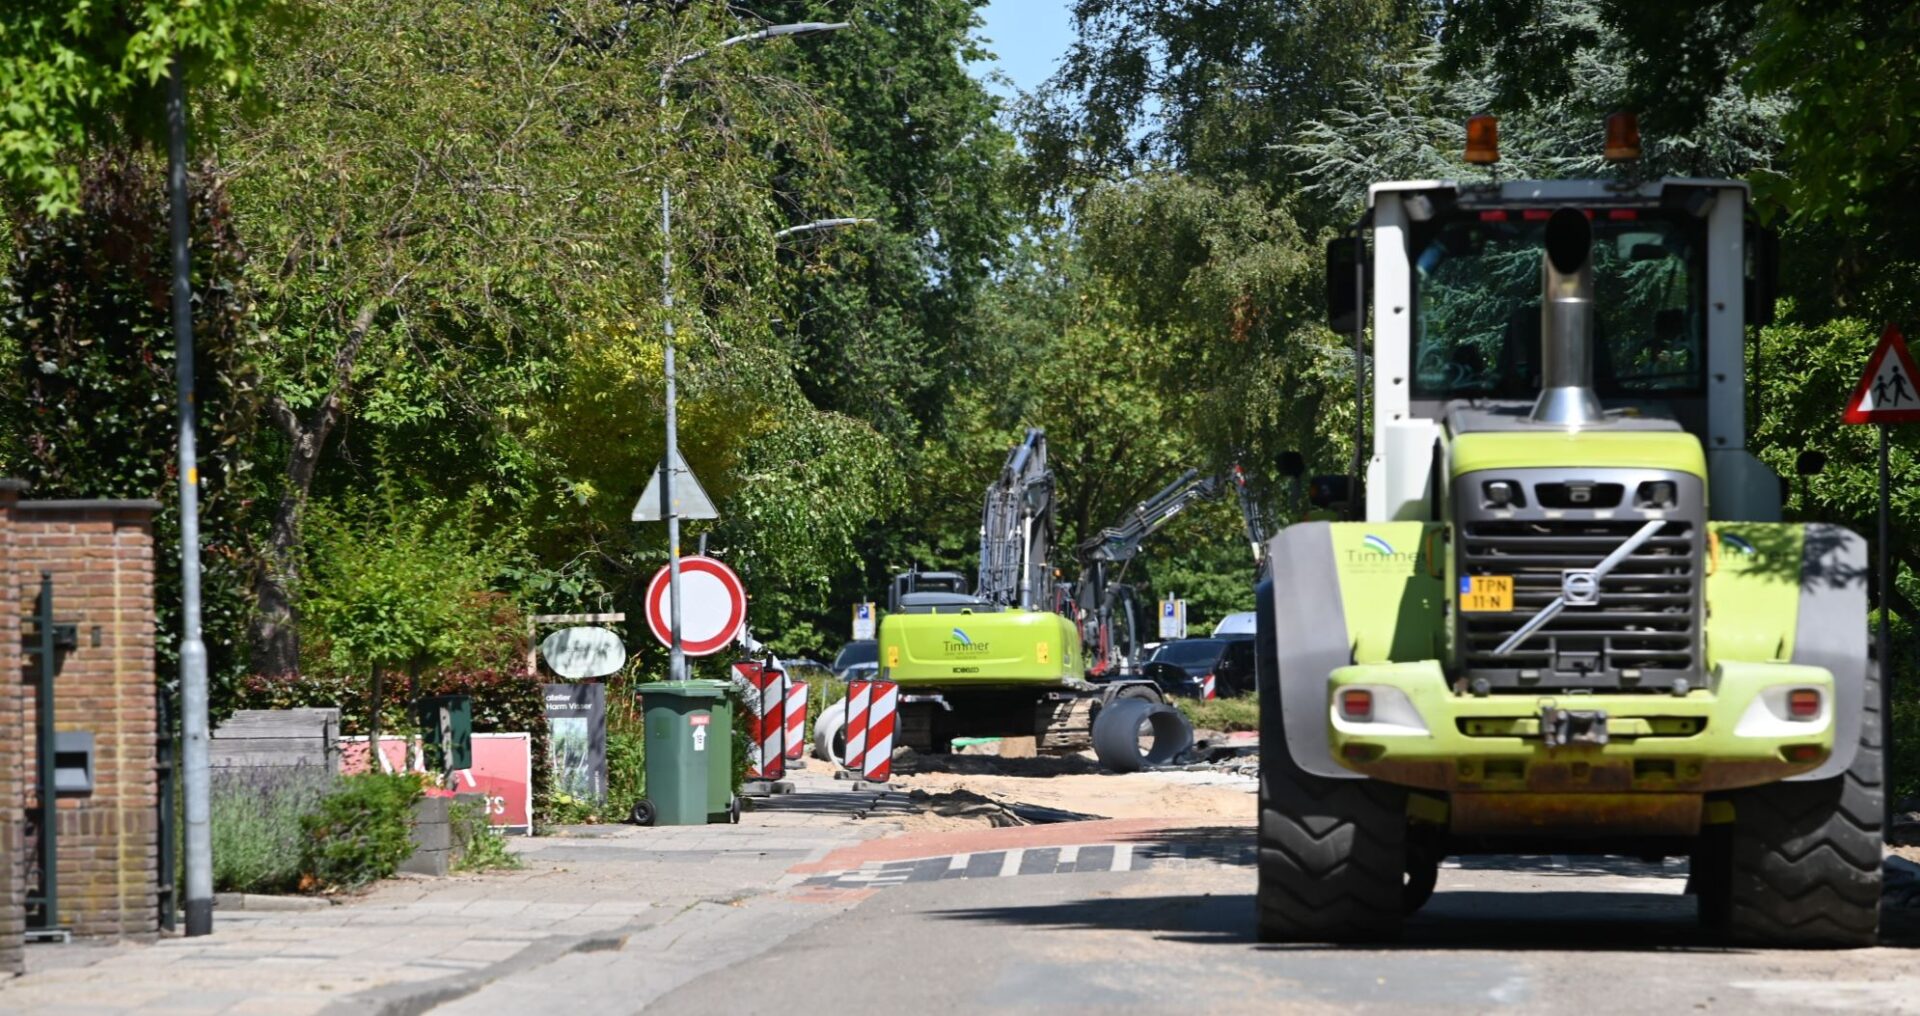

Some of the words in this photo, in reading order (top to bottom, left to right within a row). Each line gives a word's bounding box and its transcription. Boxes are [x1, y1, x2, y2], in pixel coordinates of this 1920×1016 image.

[1477, 579, 1507, 592] TPN
[1473, 595, 1501, 608] 11-N
[943, 640, 990, 652] Timmer
[546, 694, 571, 702] atelier
